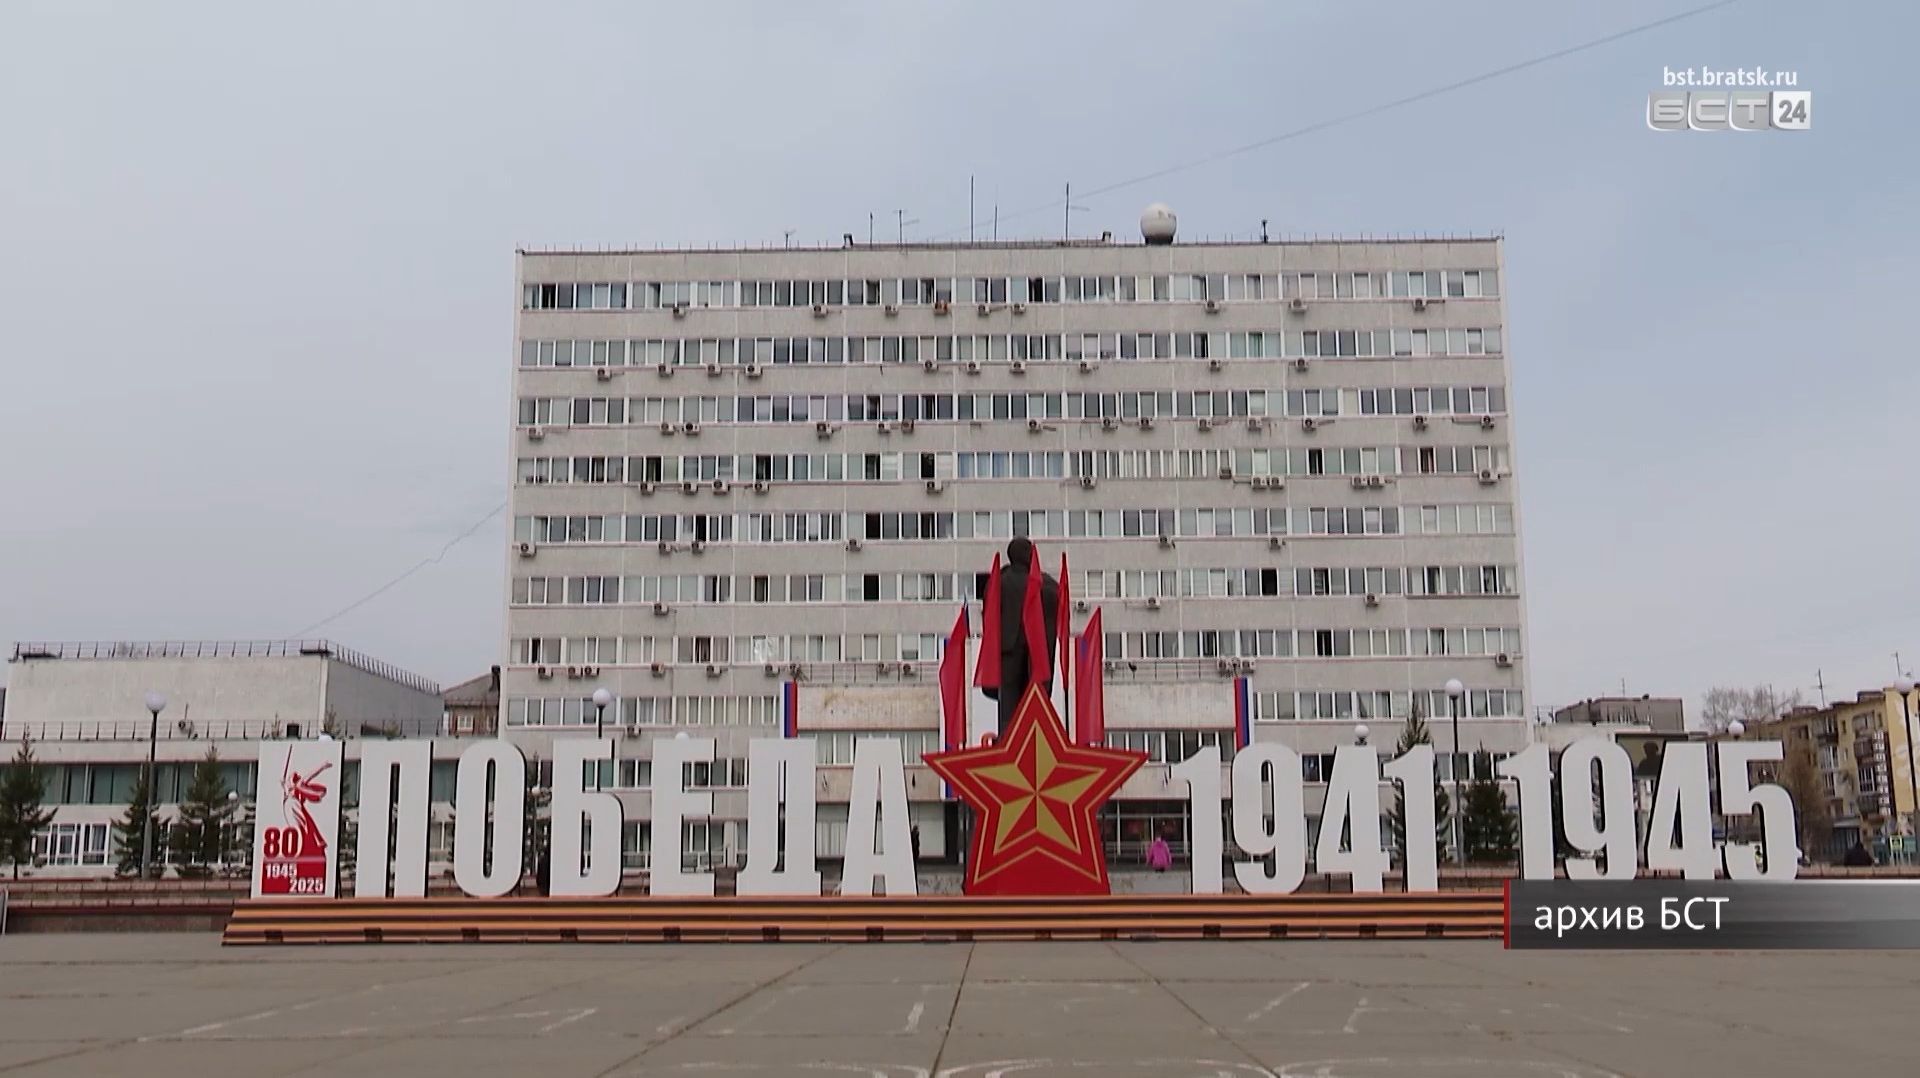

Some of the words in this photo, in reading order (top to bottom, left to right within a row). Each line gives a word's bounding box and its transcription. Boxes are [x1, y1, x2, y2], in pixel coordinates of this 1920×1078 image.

[355, 739, 917, 898] ПОБЕДА
[1170, 742, 1439, 894] 1941
[1499, 738, 1798, 880] 1945
[263, 827, 299, 858] 80
[265, 863, 298, 879] 1945
[289, 878, 324, 893] 2025
